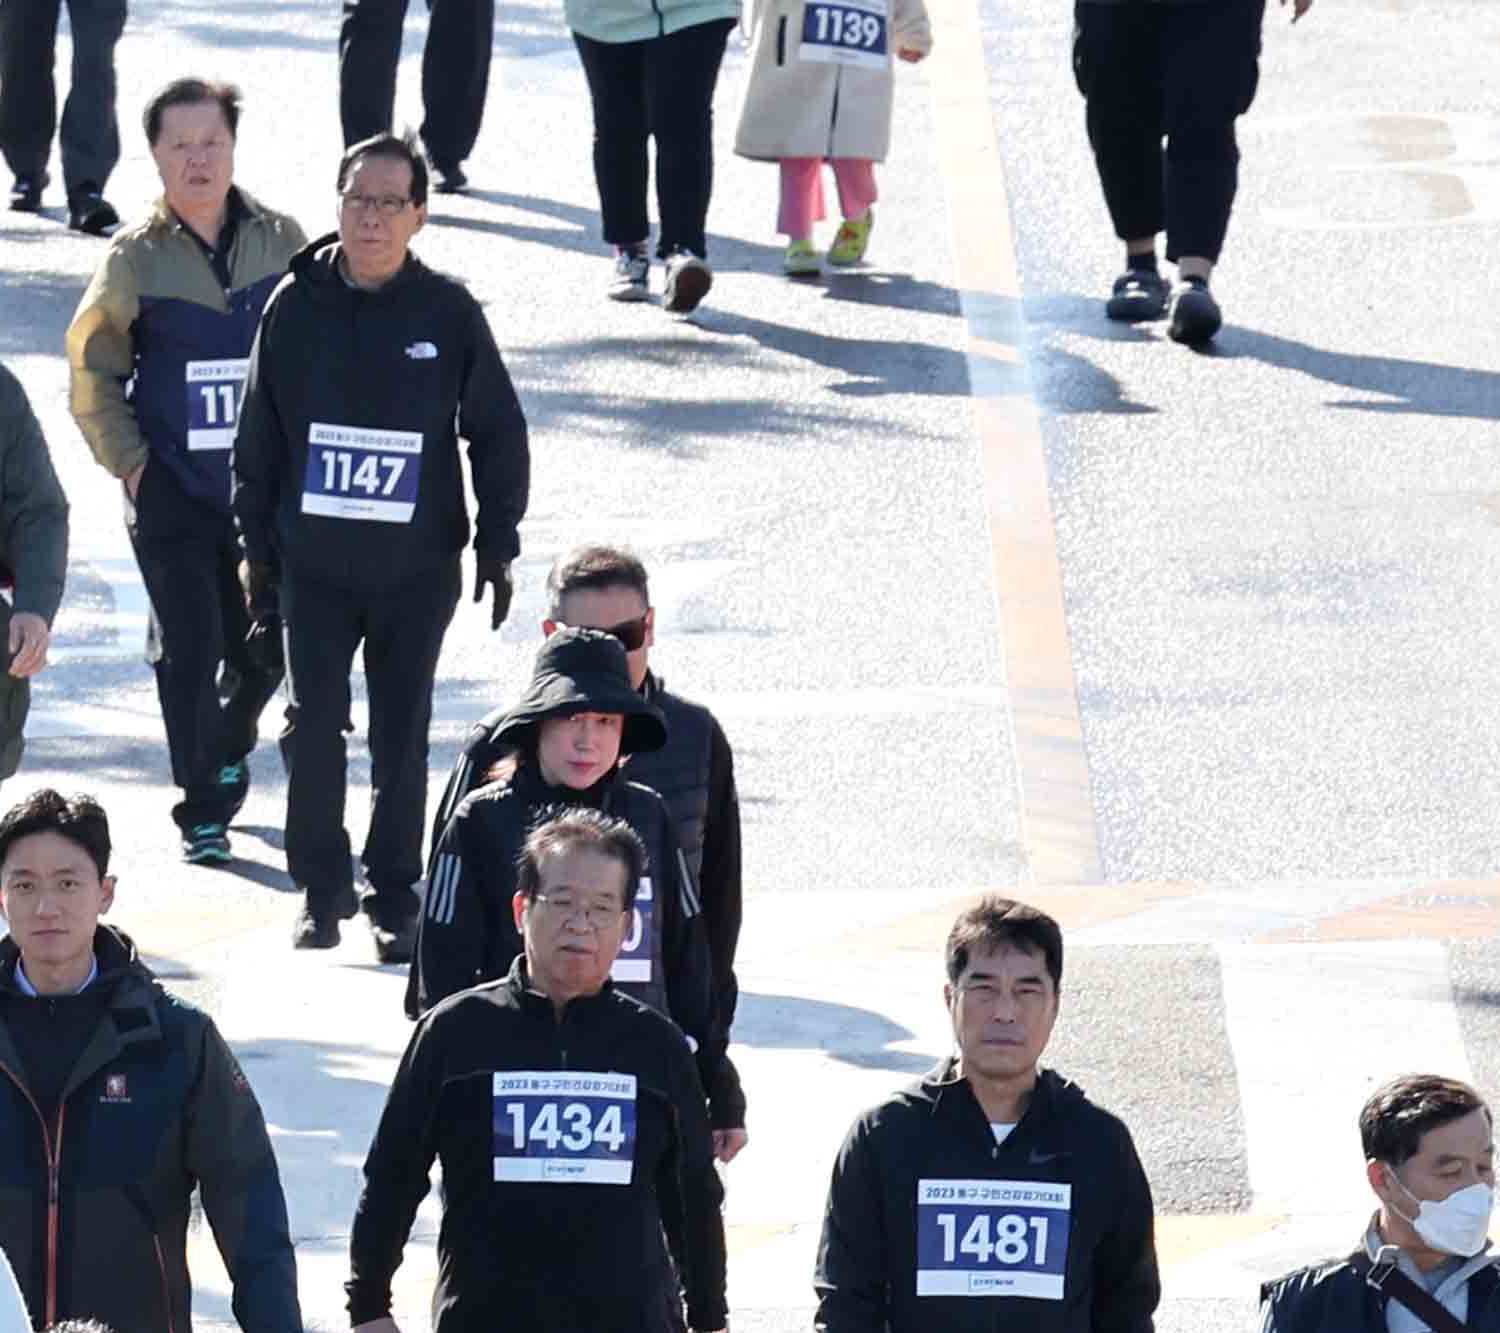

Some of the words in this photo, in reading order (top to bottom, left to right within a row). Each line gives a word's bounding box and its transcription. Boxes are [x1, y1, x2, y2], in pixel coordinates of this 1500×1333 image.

[815, 7, 880, 47] 1139
[201, 385, 238, 423] 11
[321, 450, 406, 495] 1147
[506, 1103, 626, 1152] 1434
[925, 1187, 955, 1199] 2023
[936, 1213, 1049, 1265] 1481
